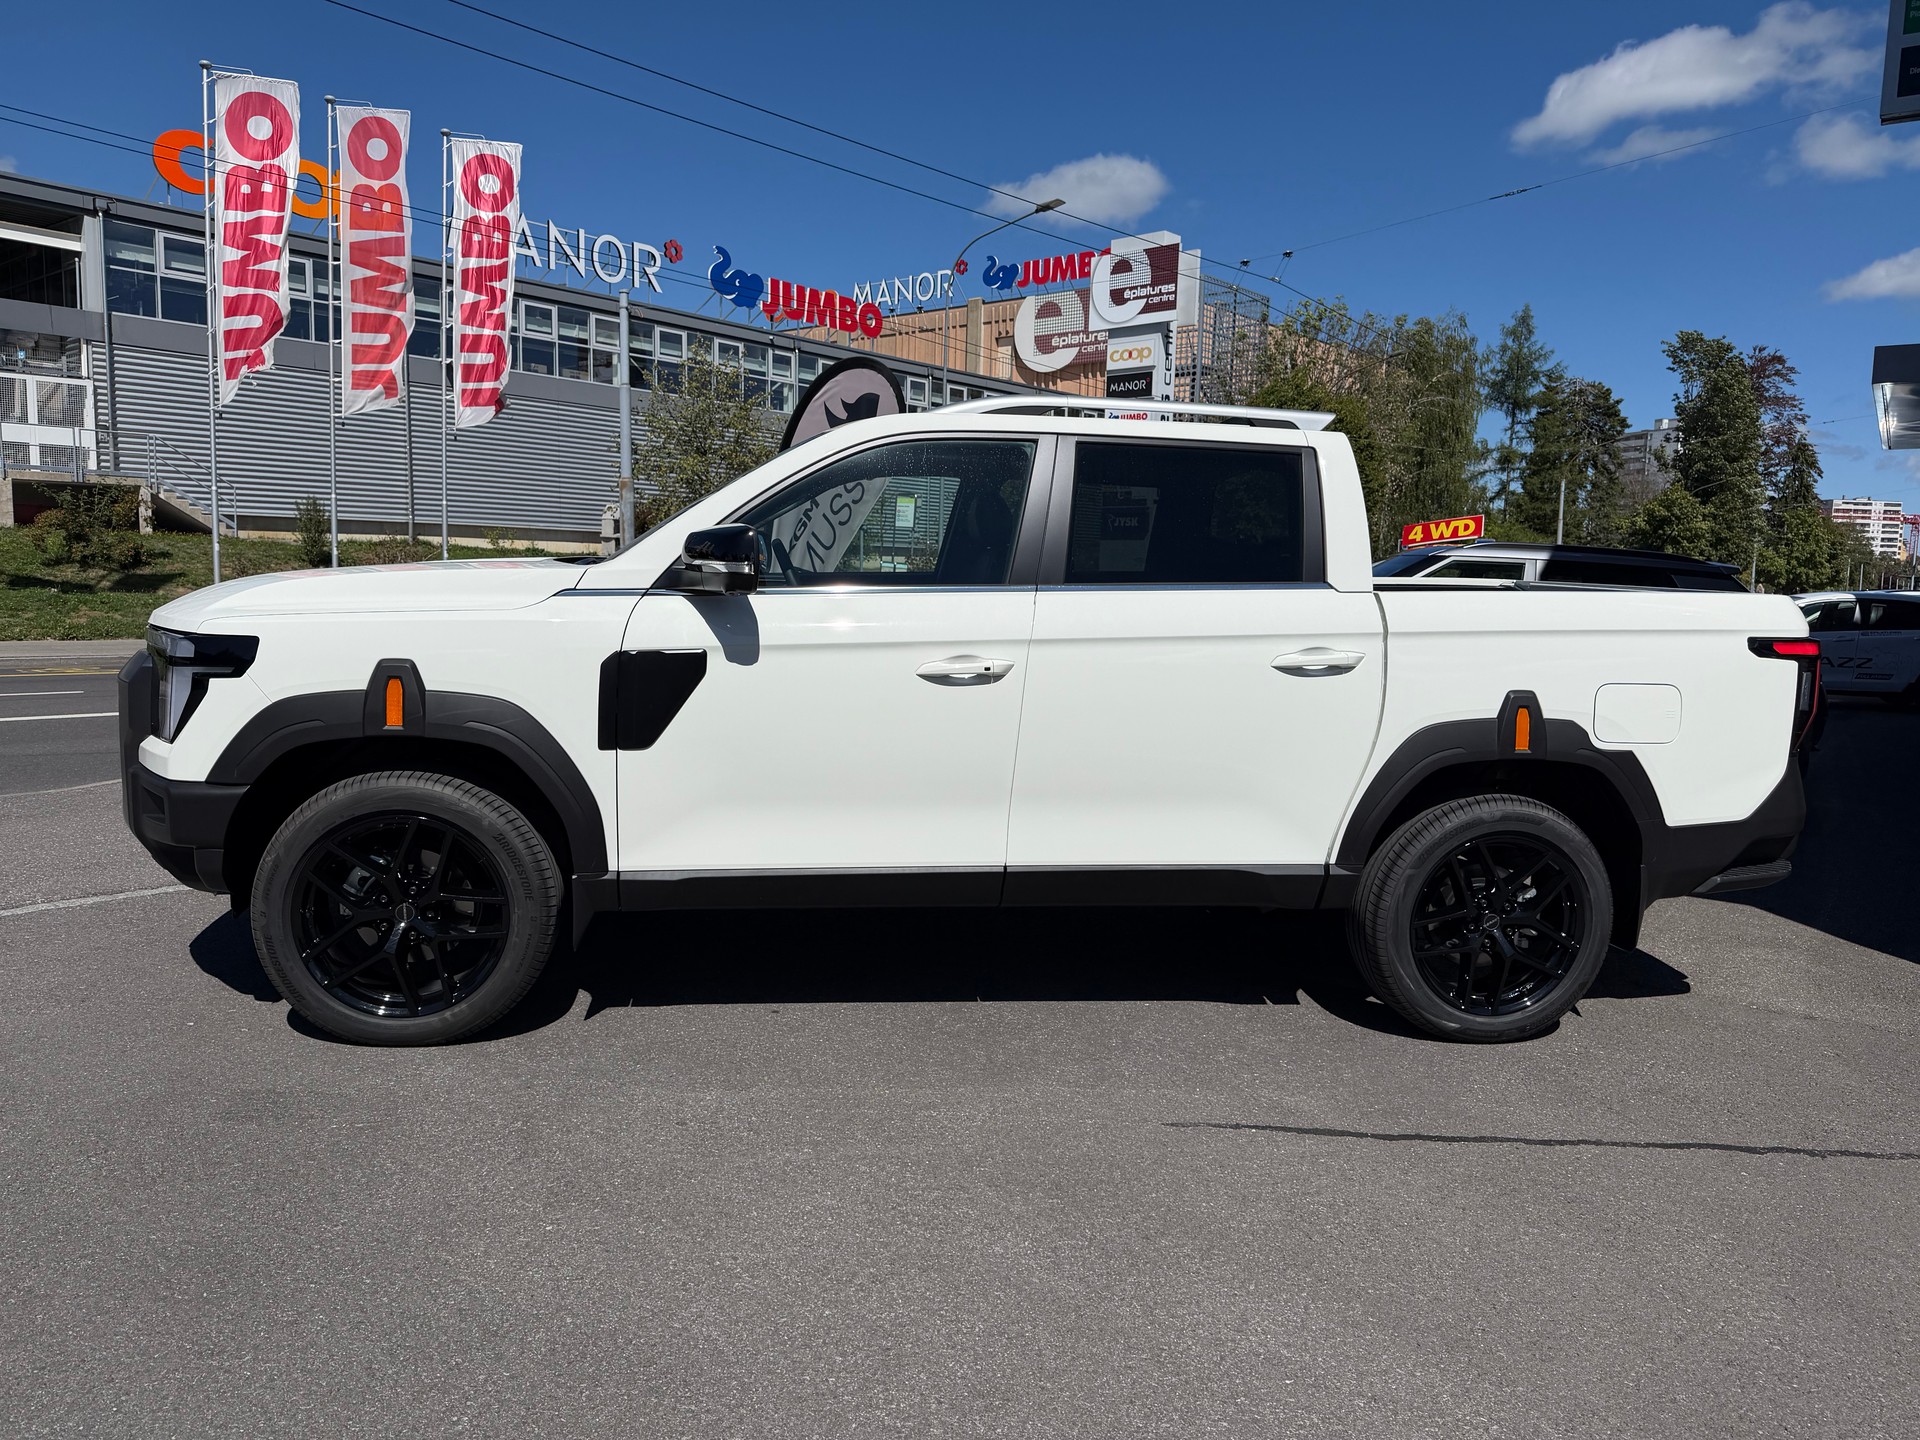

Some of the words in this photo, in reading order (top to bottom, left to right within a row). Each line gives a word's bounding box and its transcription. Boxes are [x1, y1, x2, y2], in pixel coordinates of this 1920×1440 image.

[223, 92, 293, 380] JUMBO
[448, 213, 663, 294] ANOR
[347, 116, 403, 400] JUMBO
[1017, 248, 1111, 288] JUMB
[460, 153, 515, 416] JUMBO
[853, 269, 954, 306] MANOR
[1124, 284, 1176, 299] éplatures
[1148, 293, 1175, 304] centre
[761, 277, 883, 338] JUMBO
[1081, 342, 1108, 353] centr
[1109, 346, 1152, 363] coop
[1164, 321, 1173, 386] centr
[1109, 380, 1146, 392] MANOR
[1114, 516, 1139, 527] JYSK
[1408, 525, 1424, 542] 4
[1429, 519, 1476, 540] WD
[1820, 656, 1873, 669] AZZ
[492, 832, 534, 902] BRIDGESTONE
[264, 933, 306, 1004] BRIDGESTONE
